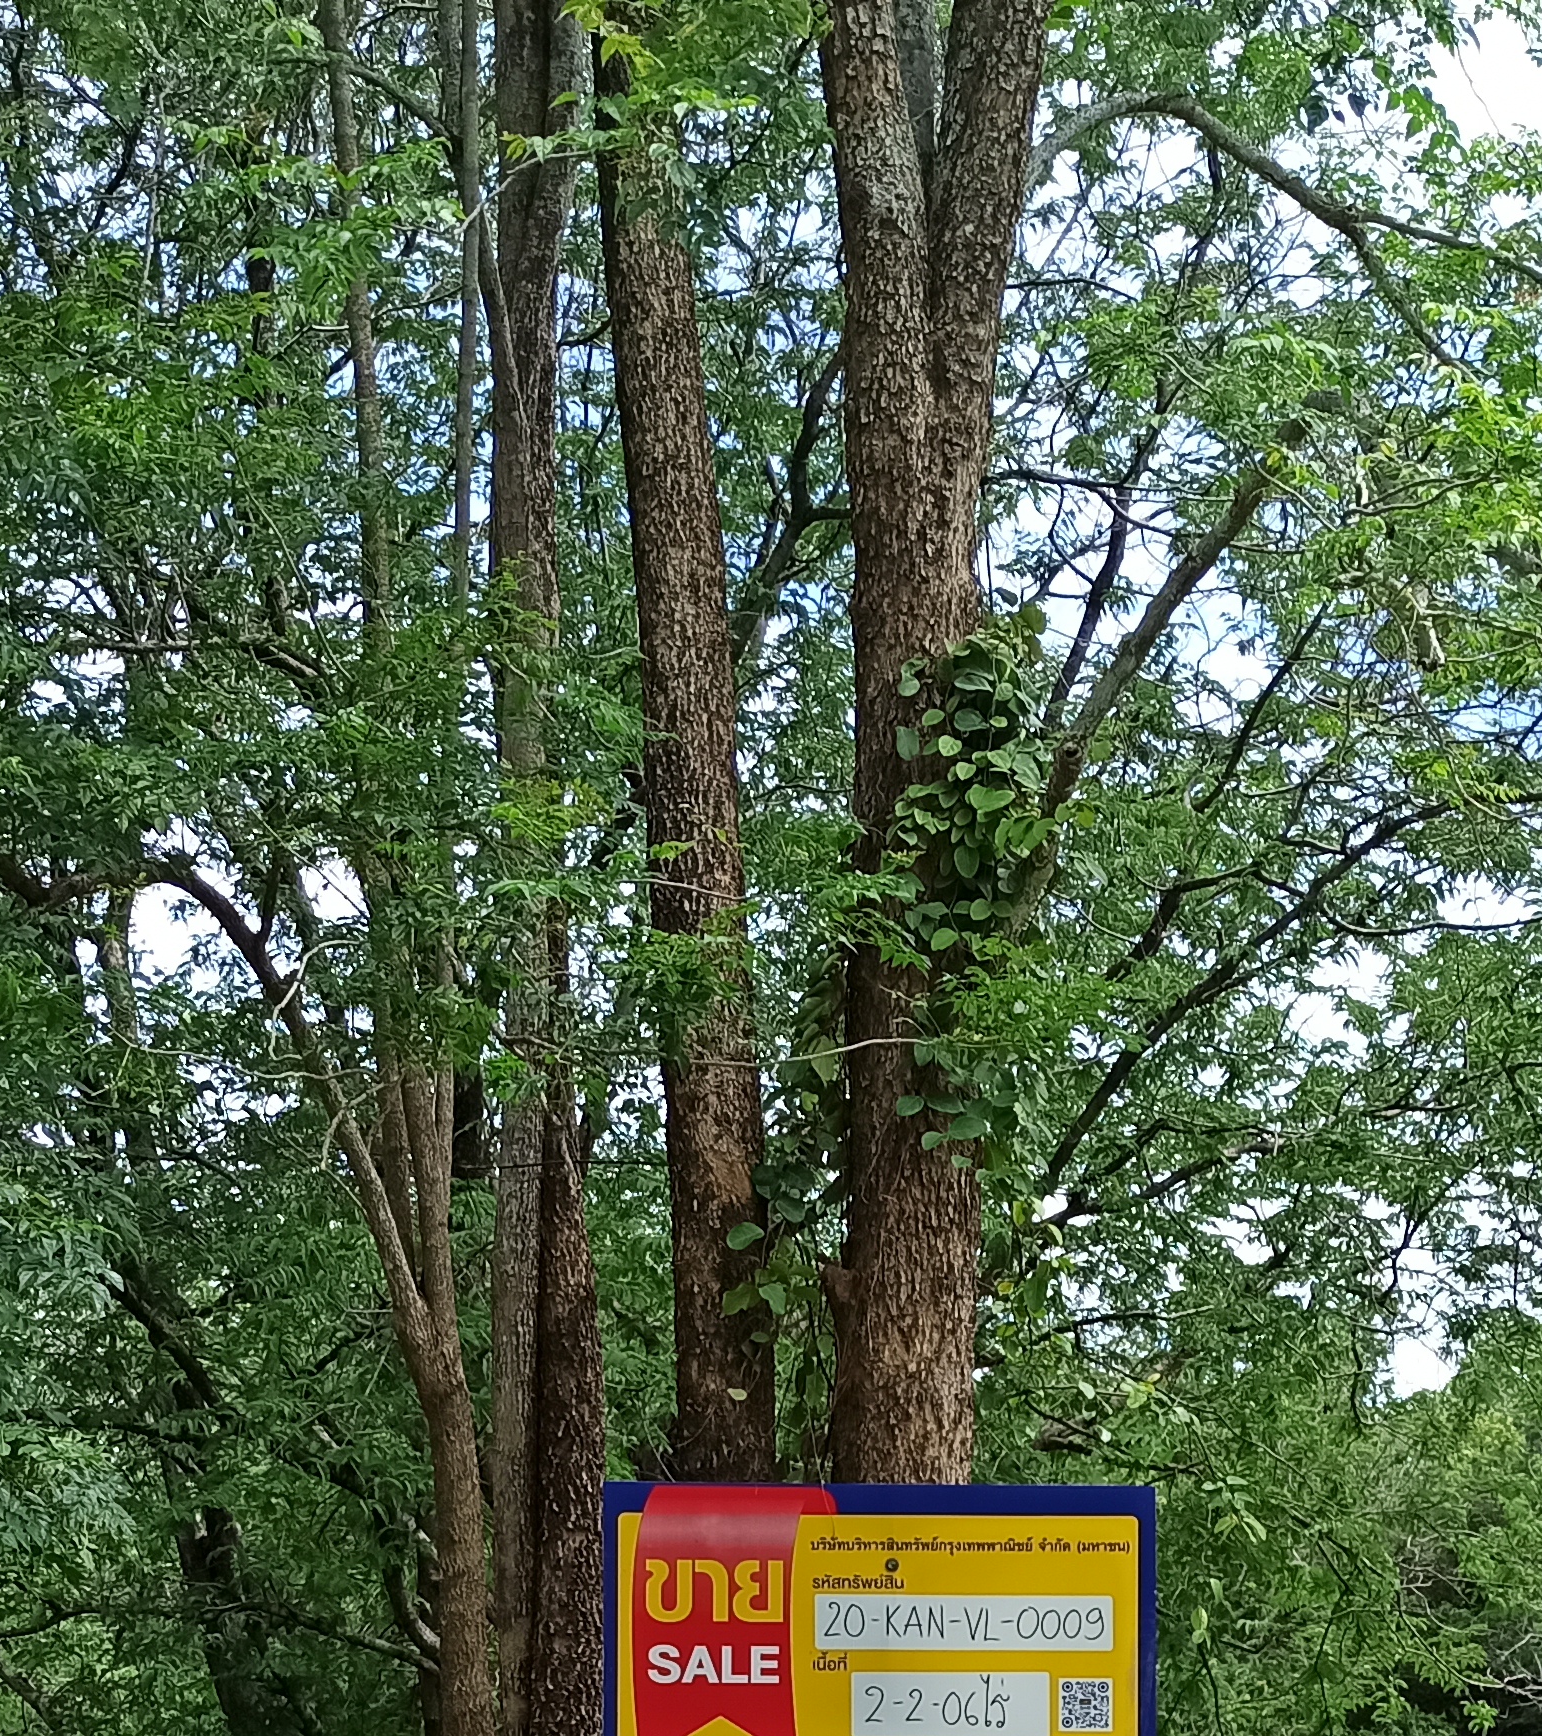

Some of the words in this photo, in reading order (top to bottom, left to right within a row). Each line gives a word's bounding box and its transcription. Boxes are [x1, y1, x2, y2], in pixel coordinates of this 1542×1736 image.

[1039, 1538, 1071, 1553] จำกัด
[1077, 1540, 1131, 1555] (มหาชน)
[645, 1558, 784, 1623] ขาย
[812, 1573, 905, 1590] รหัสทรัพย์สิน
[824, 1601, 1105, 1641] 20-KAN-VL-0009
[647, 1644, 781, 1685] SALE
[812, 1651, 848, 1672] เนื้อที่
